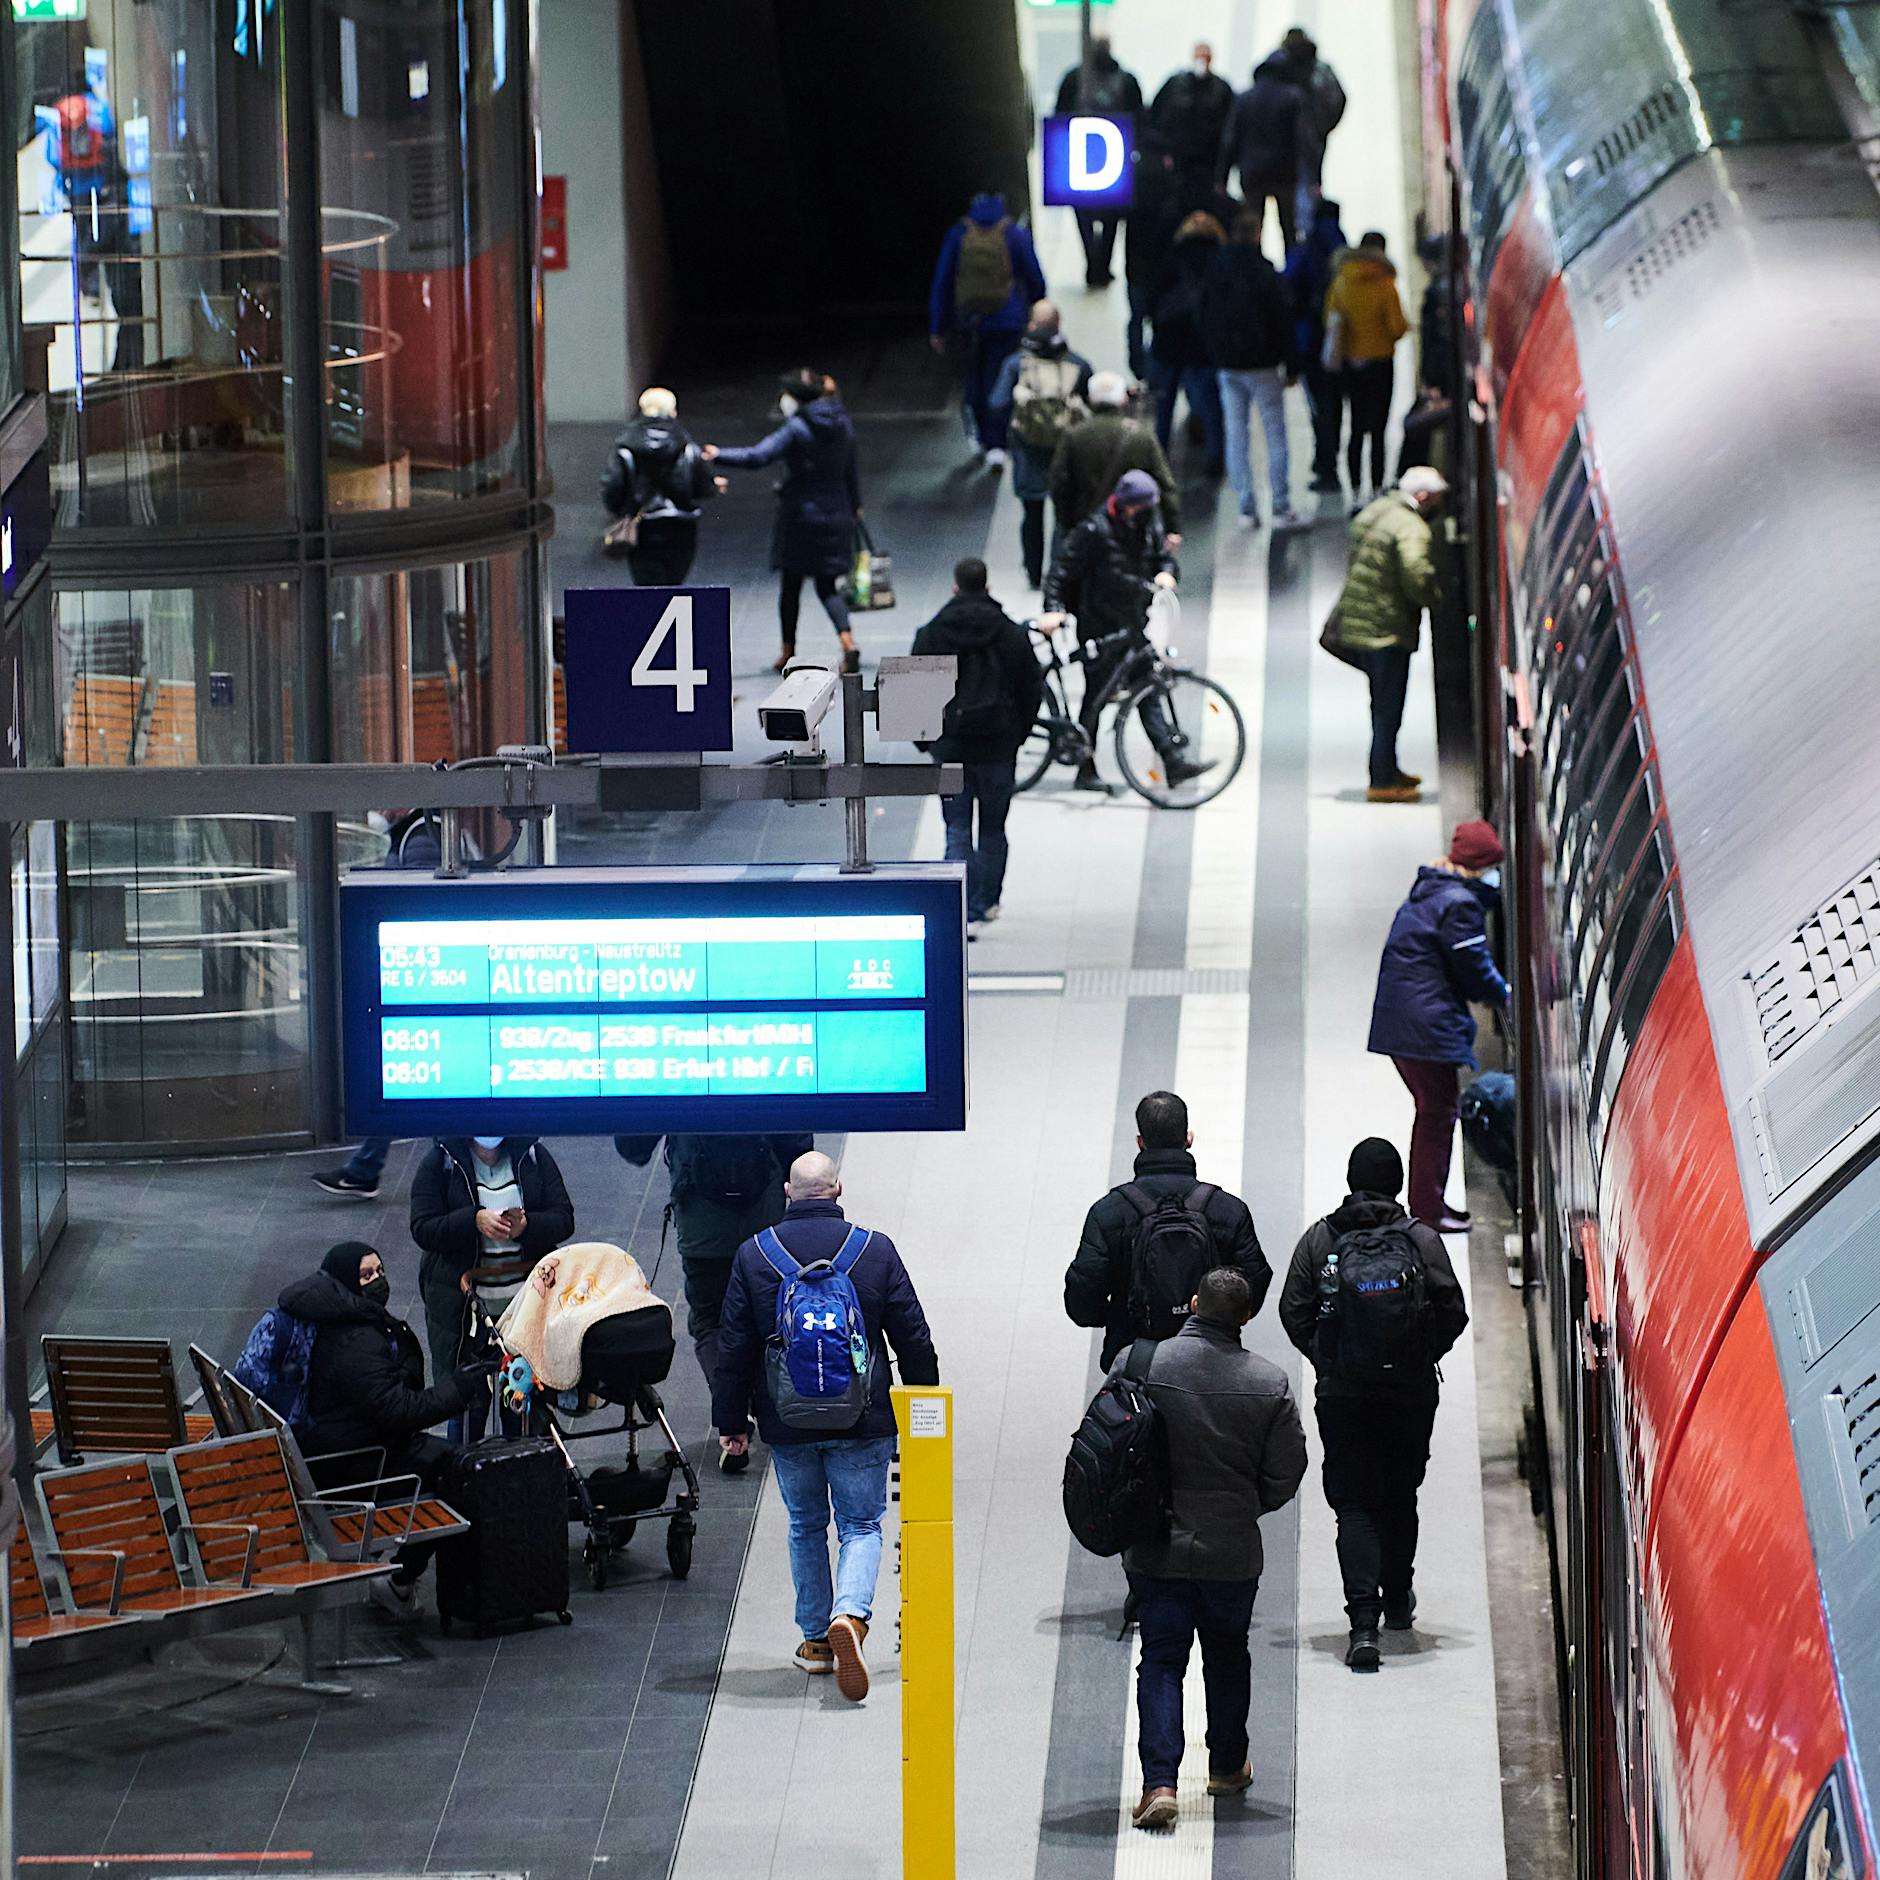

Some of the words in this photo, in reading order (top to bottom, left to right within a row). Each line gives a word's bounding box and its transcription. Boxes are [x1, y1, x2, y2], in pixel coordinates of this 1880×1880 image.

[1069, 116, 1125, 192] D
[631, 595, 708, 713] 4
[381, 946, 441, 968] 05:43
[882, 959, 892, 971] C
[381, 969, 400, 987] RE
[417, 969, 427, 987] /
[492, 963, 695, 999] Altentreptow
[383, 1029, 441, 1052] 06:01
[383, 1061, 442, 1085] 06:01
[662, 1056, 727, 1079] Erfurt
[732, 1055, 770, 1078] Hbf
[776, 1055, 789, 1078] /
